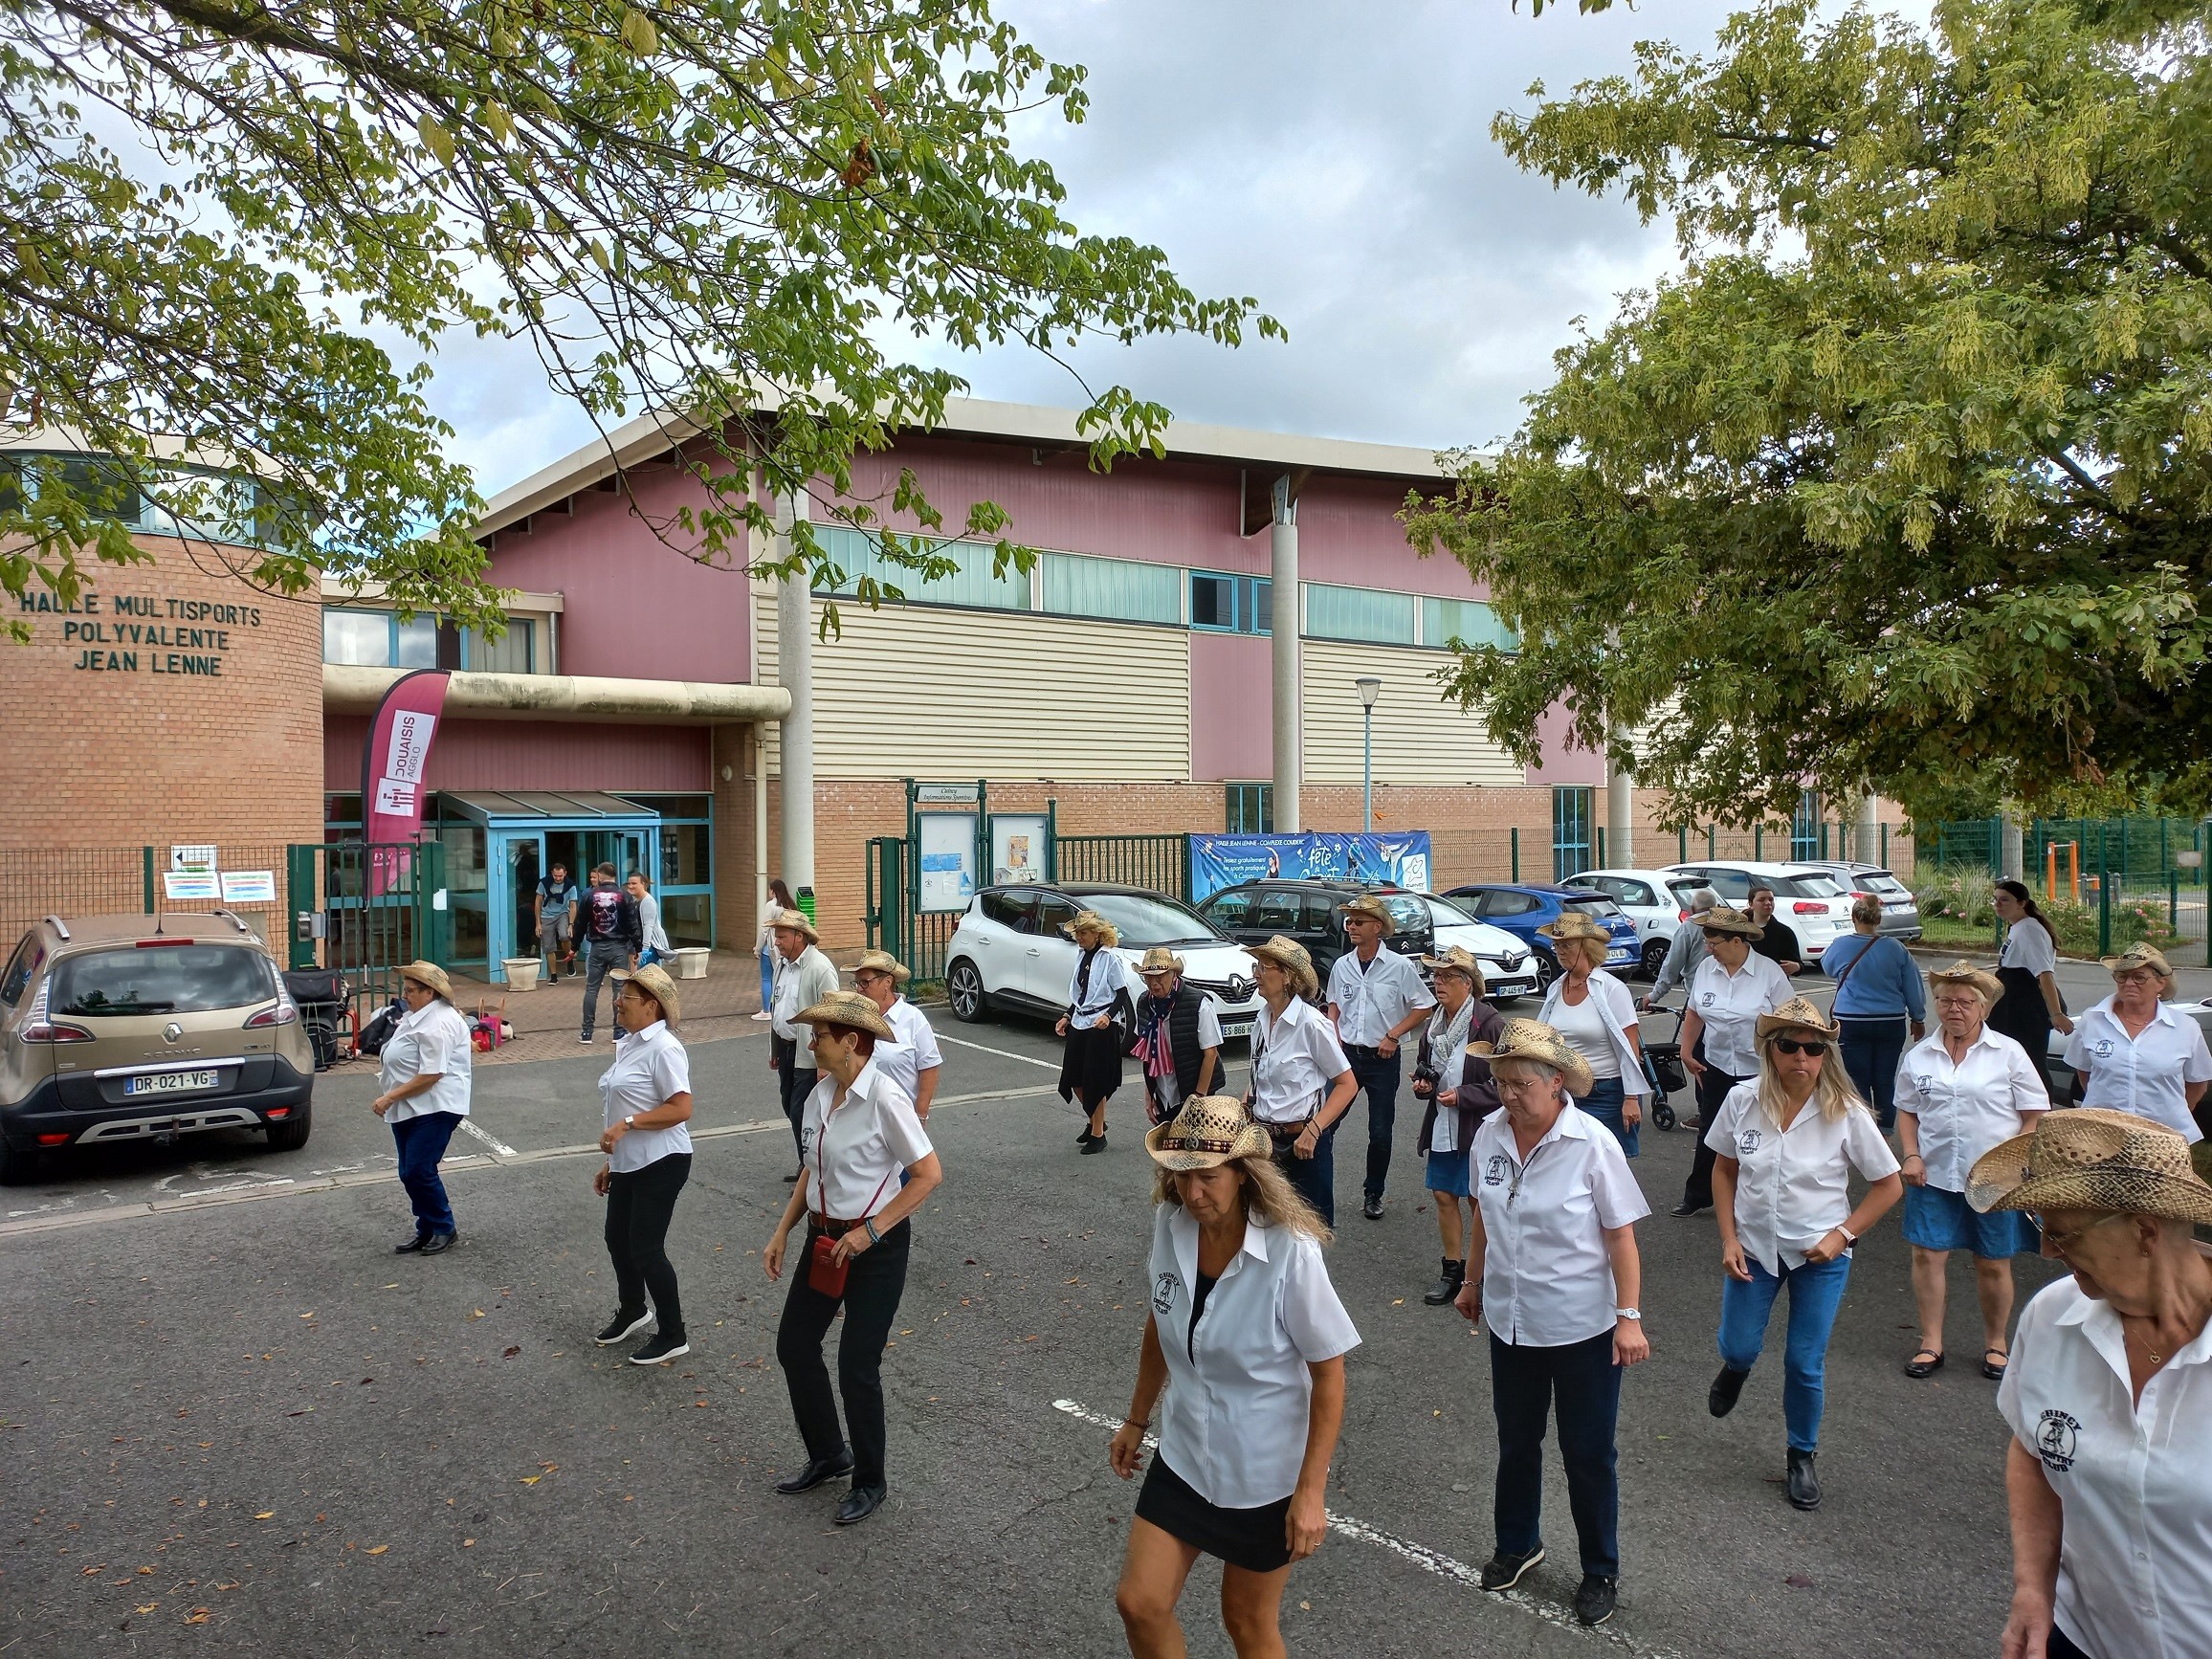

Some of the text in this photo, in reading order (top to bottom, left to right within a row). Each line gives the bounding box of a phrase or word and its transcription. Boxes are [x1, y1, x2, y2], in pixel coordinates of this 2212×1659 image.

[20, 591, 261, 627] HALLE MULTISPORTS
[64, 621, 231, 651] POLYVALENTE
[74, 650, 222, 676] JEAN LENNE
[395, 716, 415, 778] DOUAISIS
[407, 746, 421, 779] AGGLO
[1237, 856, 1267, 865] gratuitement
[1308, 845, 1332, 869] fête
[135, 1072, 209, 1092] DR-021-VG
[1159, 1272, 1181, 1287] CUINCY
[2040, 1409, 2083, 1432] CUINCY
[2043, 1455, 2069, 1472] CLUB
